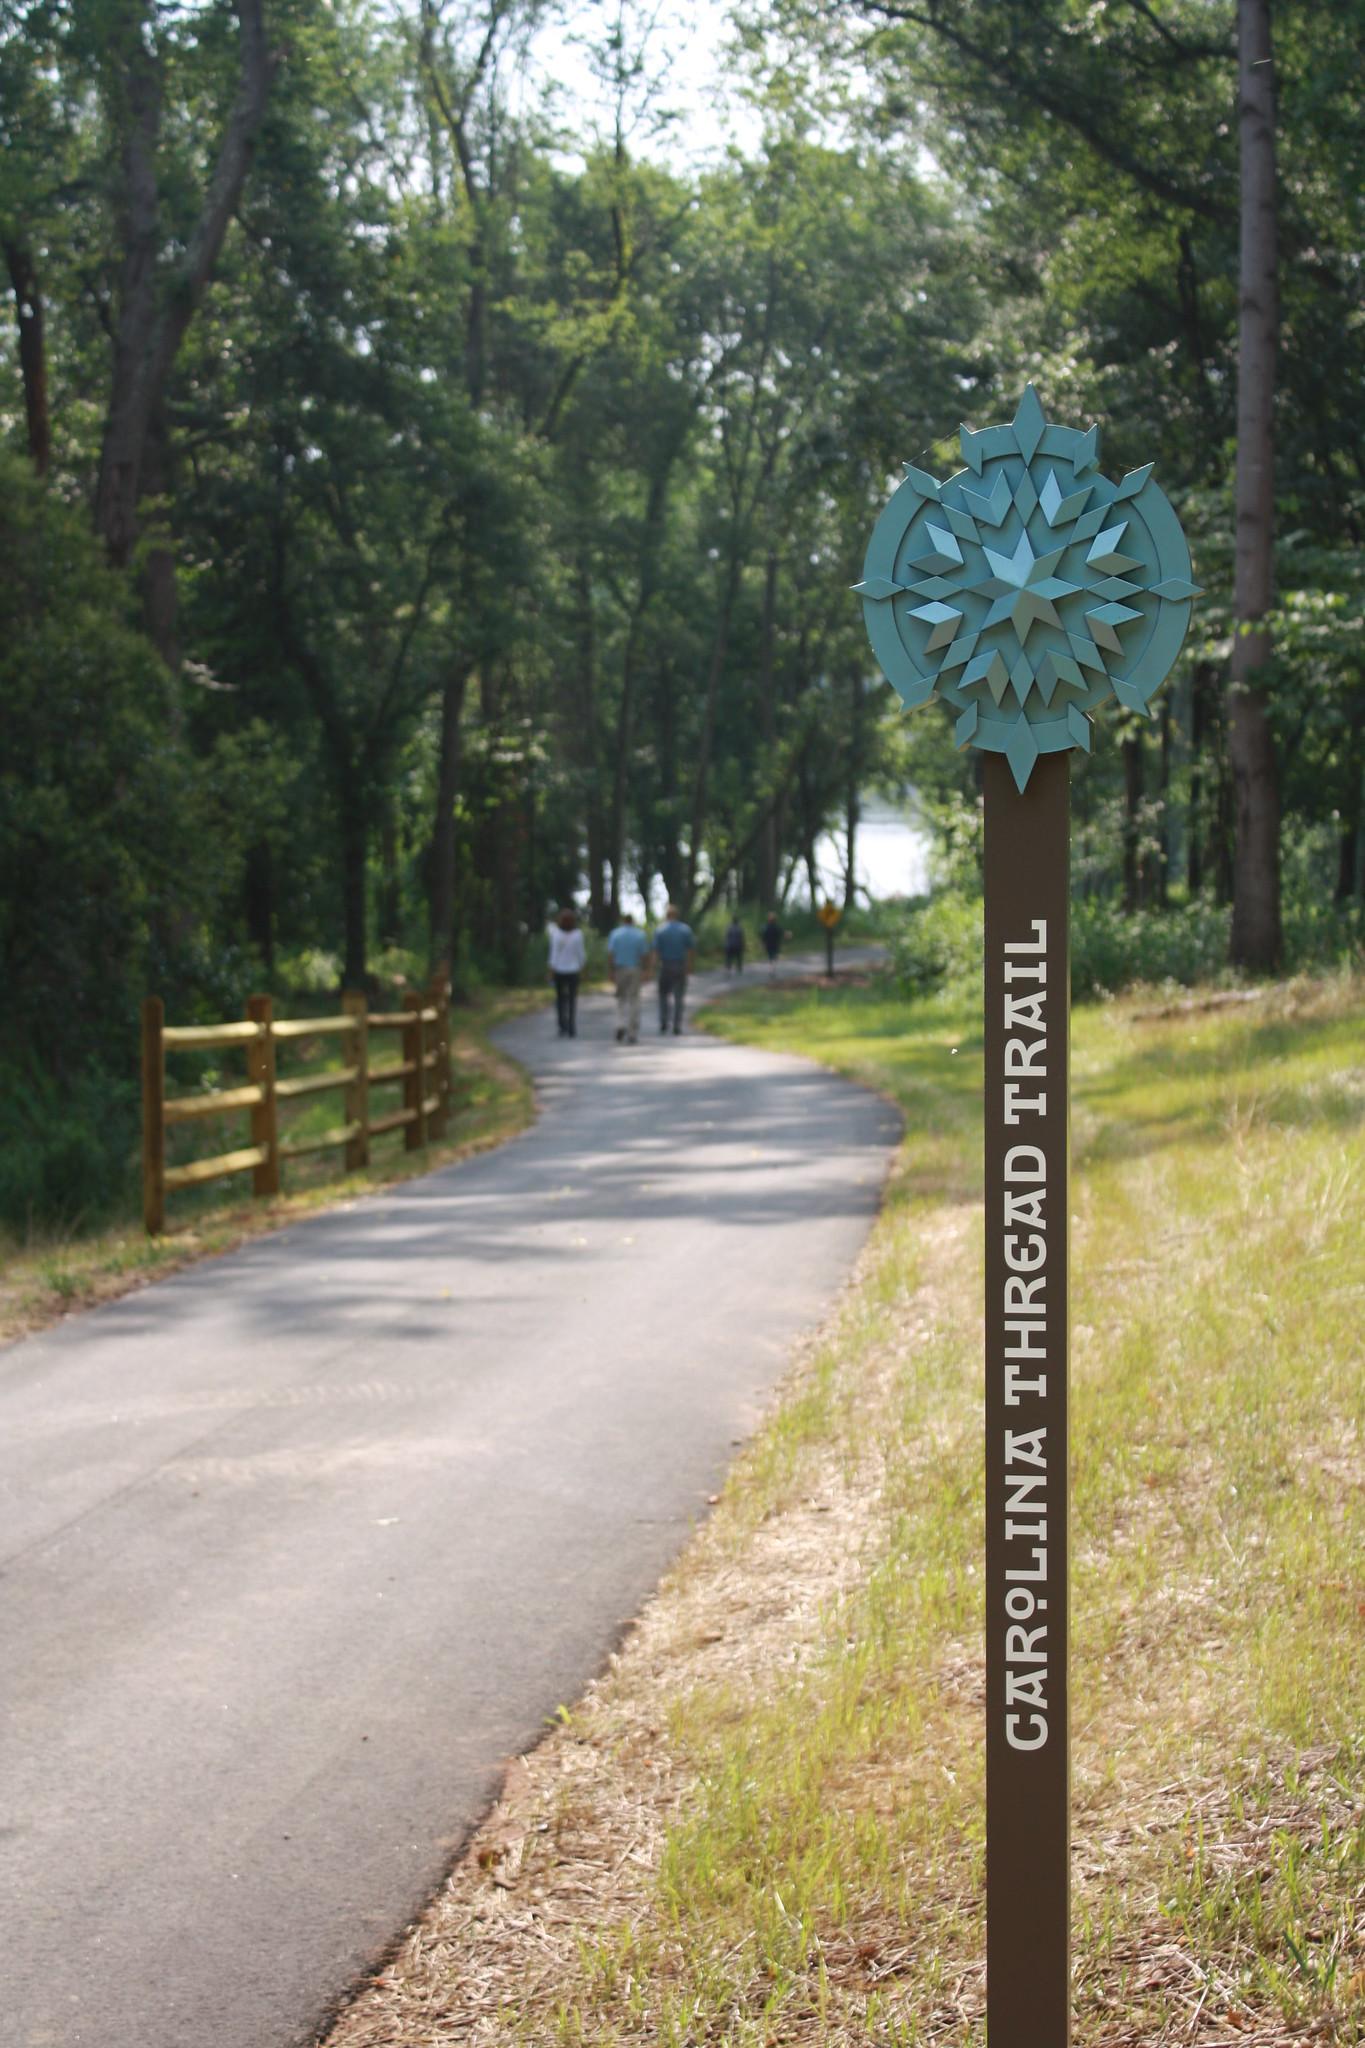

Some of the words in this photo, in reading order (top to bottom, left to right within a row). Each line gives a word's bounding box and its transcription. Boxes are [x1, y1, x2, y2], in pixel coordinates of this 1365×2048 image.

[1004, 919, 1047, 1125] TRAIL
[1003, 1145, 1046, 1406] THREAD
[1004, 1427, 1048, 1751] CAROLINA
